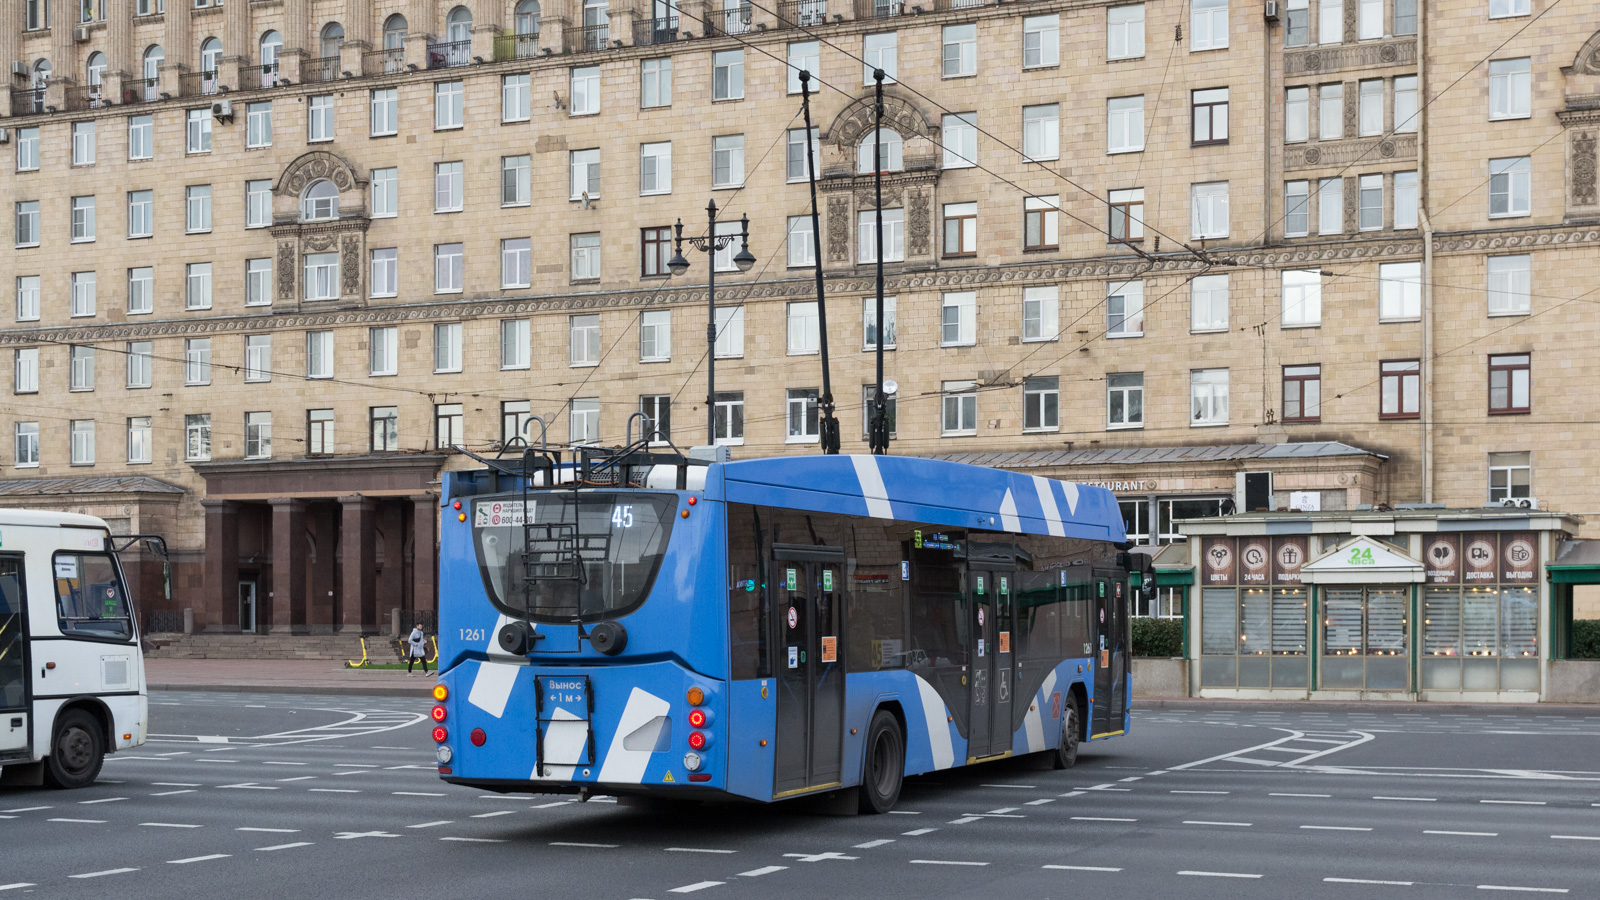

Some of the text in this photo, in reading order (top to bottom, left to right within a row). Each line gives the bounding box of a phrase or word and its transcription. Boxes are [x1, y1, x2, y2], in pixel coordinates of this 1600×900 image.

[1082, 481, 1145, 491] TAURANT
[502, 516, 533, 524] 600-44-0
[612, 505, 633, 528] 45
[1351, 547, 1372, 560] 24
[1210, 573, 1228, 581] ЦВЕТЫ
[1244, 573, 1265, 581] 24 ЧАСА
[1466, 572, 1494, 580] ДОСТАВКА
[1506, 571, 1533, 579] ВЫГОДНО
[459, 628, 486, 641] 1261
[549, 680, 581, 690] Вынос
